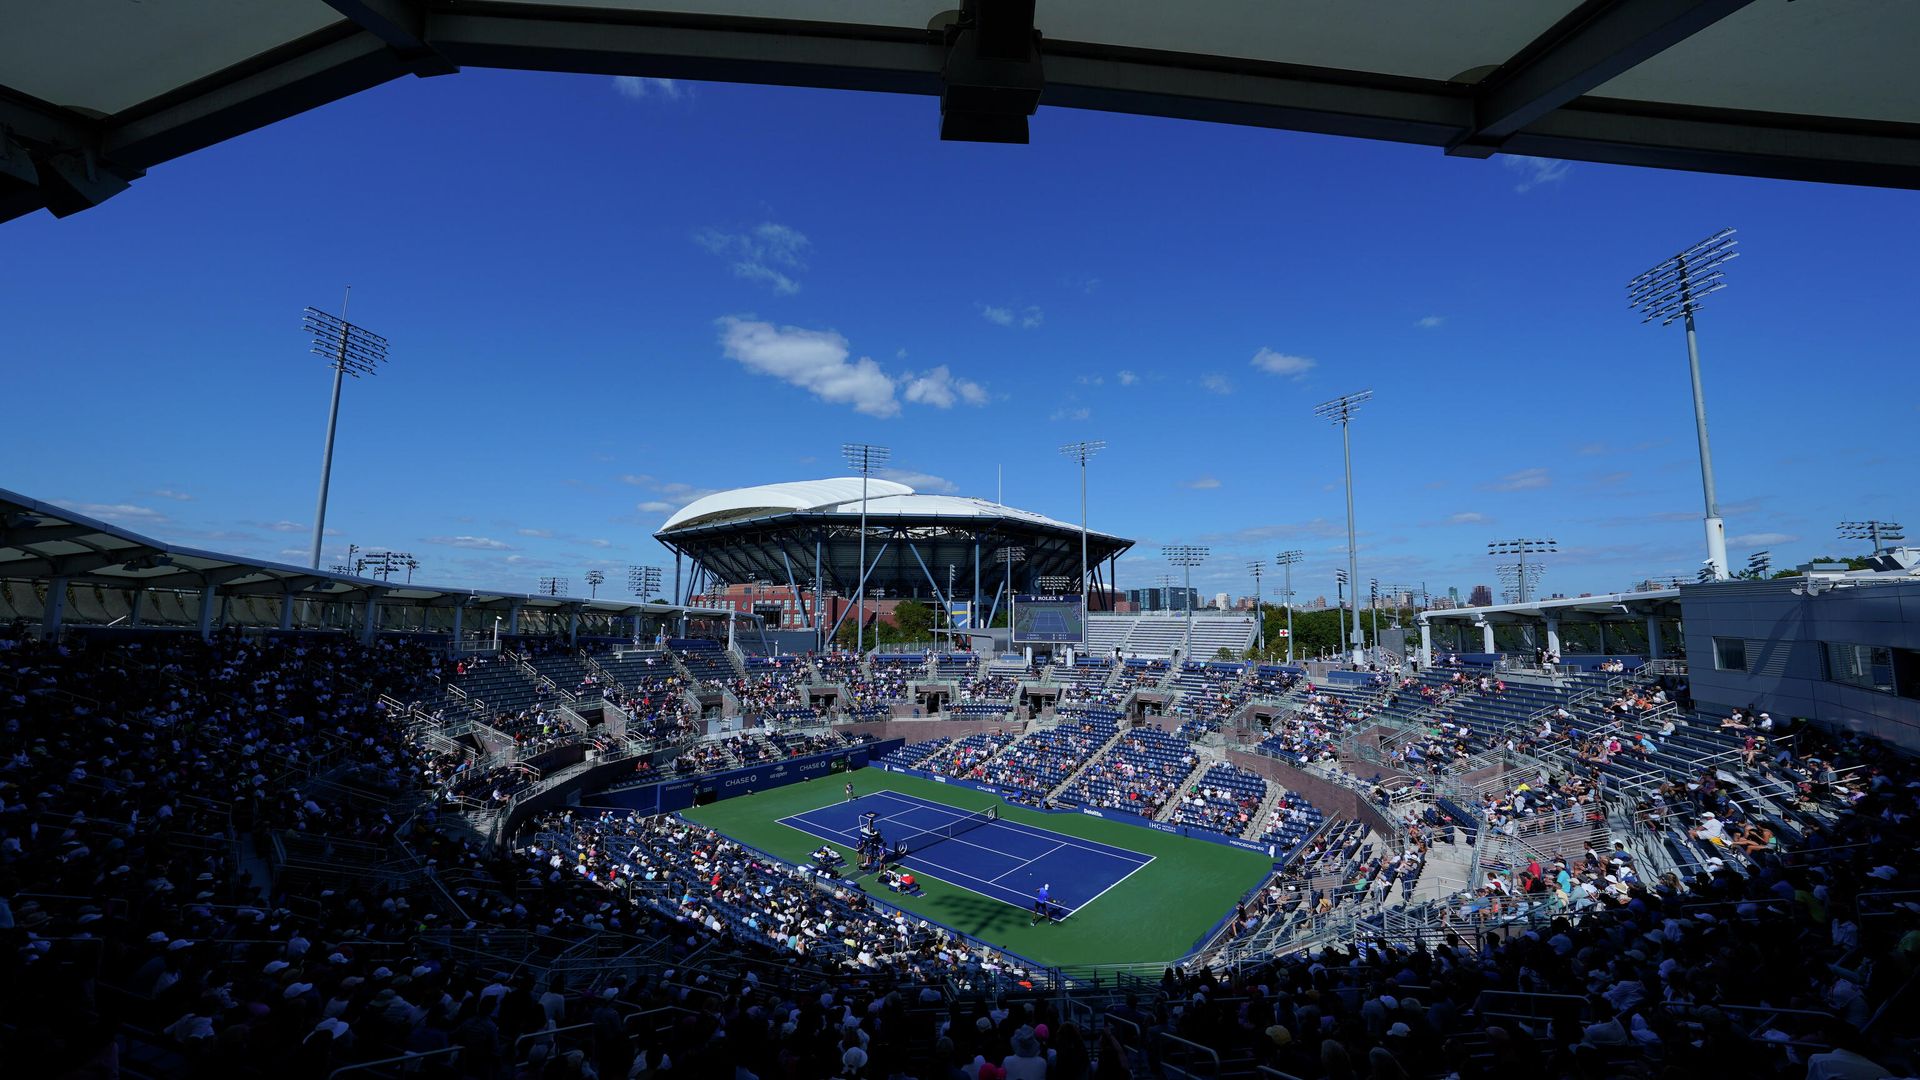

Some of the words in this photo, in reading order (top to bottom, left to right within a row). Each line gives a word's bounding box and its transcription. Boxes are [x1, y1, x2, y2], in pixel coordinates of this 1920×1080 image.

[799, 762, 821, 772] CHASE
[725, 776, 750, 787] CHASE
[976, 785, 996, 793] CHUBB
[1148, 822, 1162, 830] IHG
